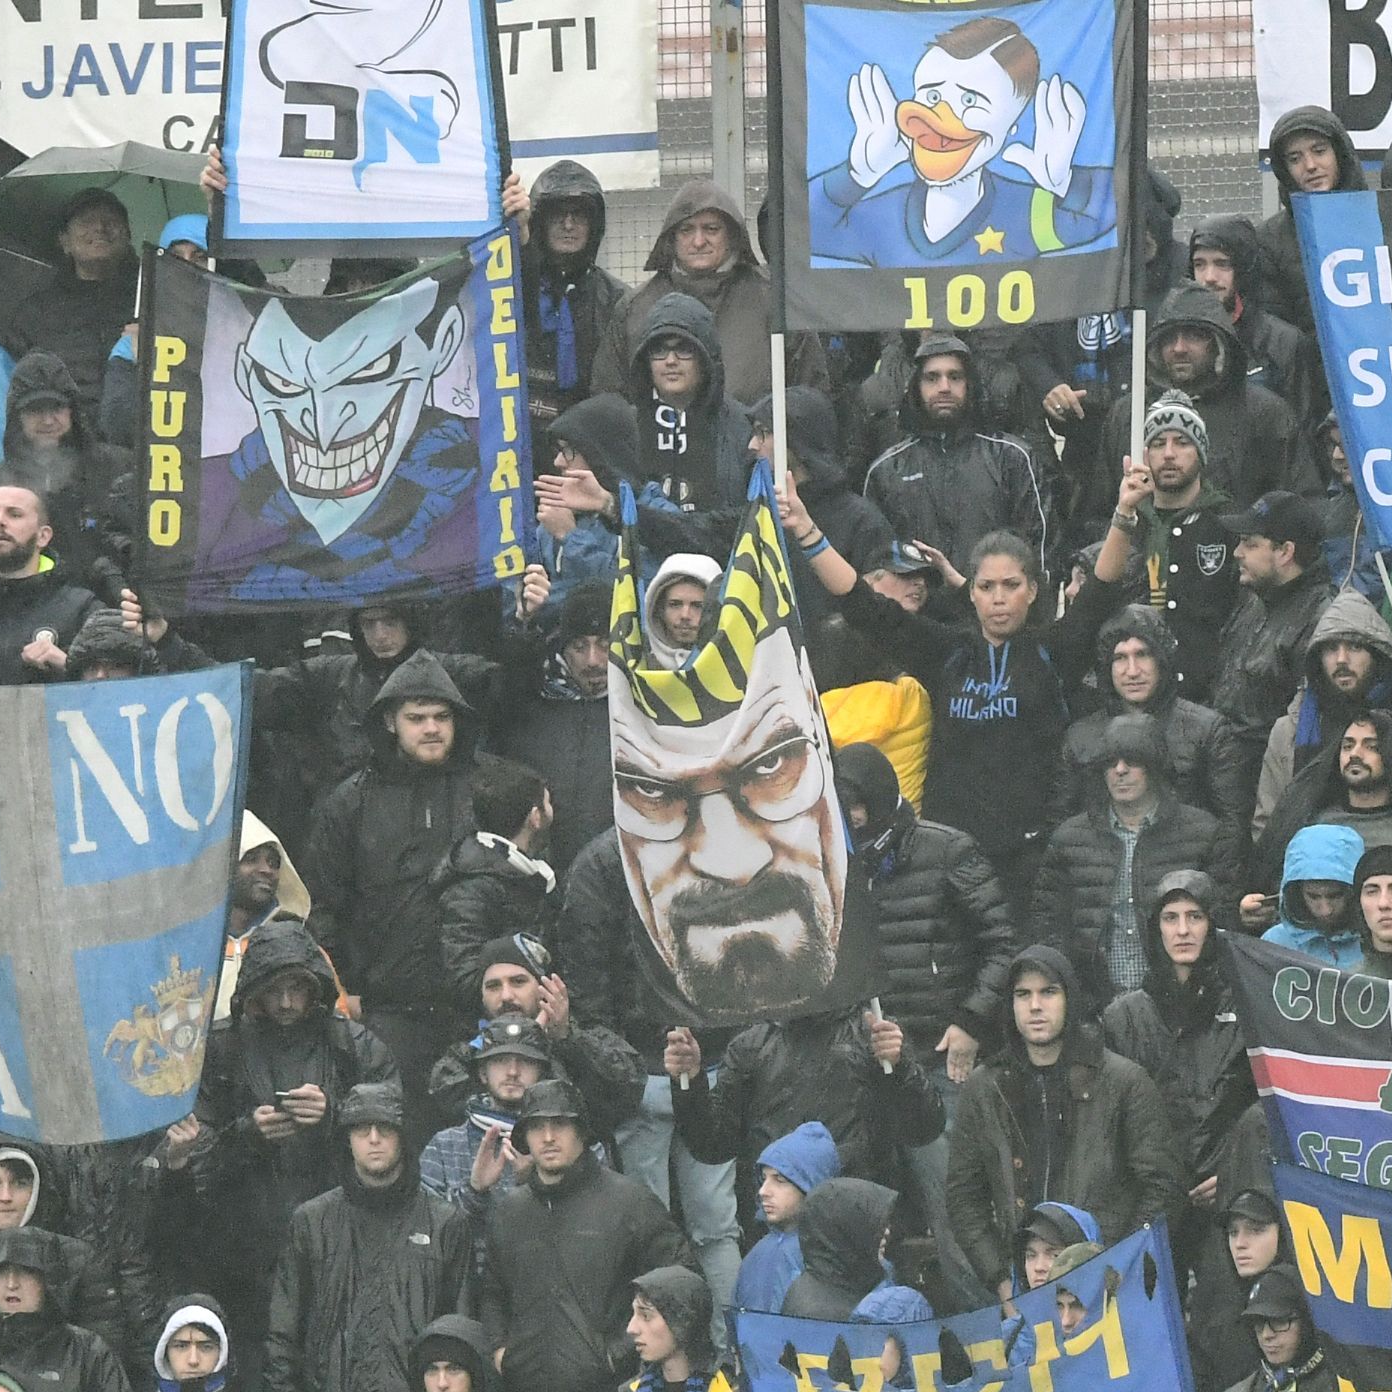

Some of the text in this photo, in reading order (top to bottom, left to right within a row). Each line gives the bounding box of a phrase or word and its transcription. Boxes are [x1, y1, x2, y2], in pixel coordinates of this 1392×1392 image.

[903, 270, 1035, 329] 100
[149, 335, 187, 548] PURO
[948, 697, 1017, 720] MILANO
[55, 692, 234, 855] NO
